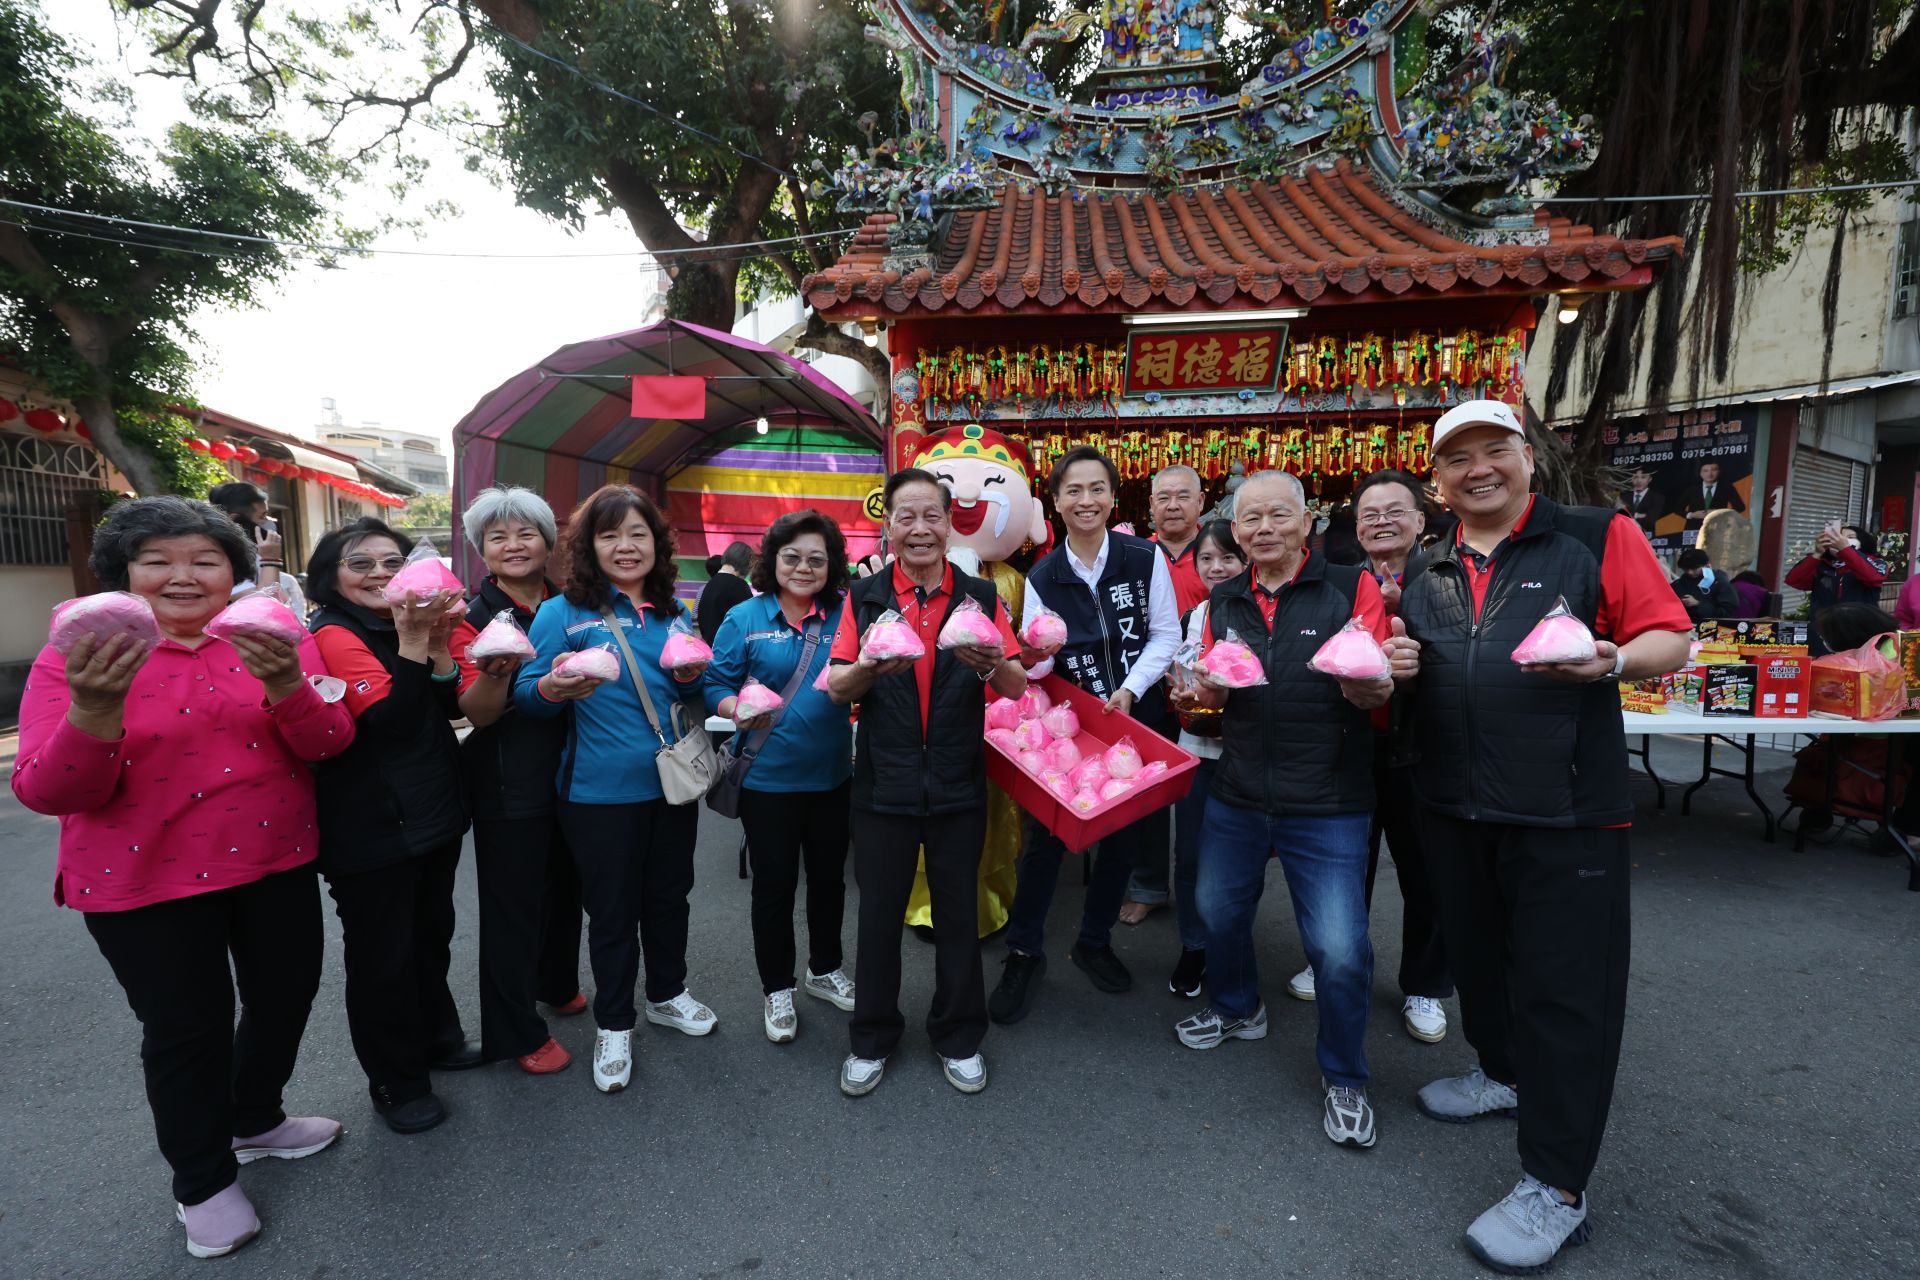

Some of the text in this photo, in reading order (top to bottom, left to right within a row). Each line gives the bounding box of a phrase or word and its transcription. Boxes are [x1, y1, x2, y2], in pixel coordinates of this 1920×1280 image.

[1135, 336, 1271, 386] 福德祠
[1521, 580, 1543, 588] FILA
[1109, 582, 1140, 675] 張又仁
